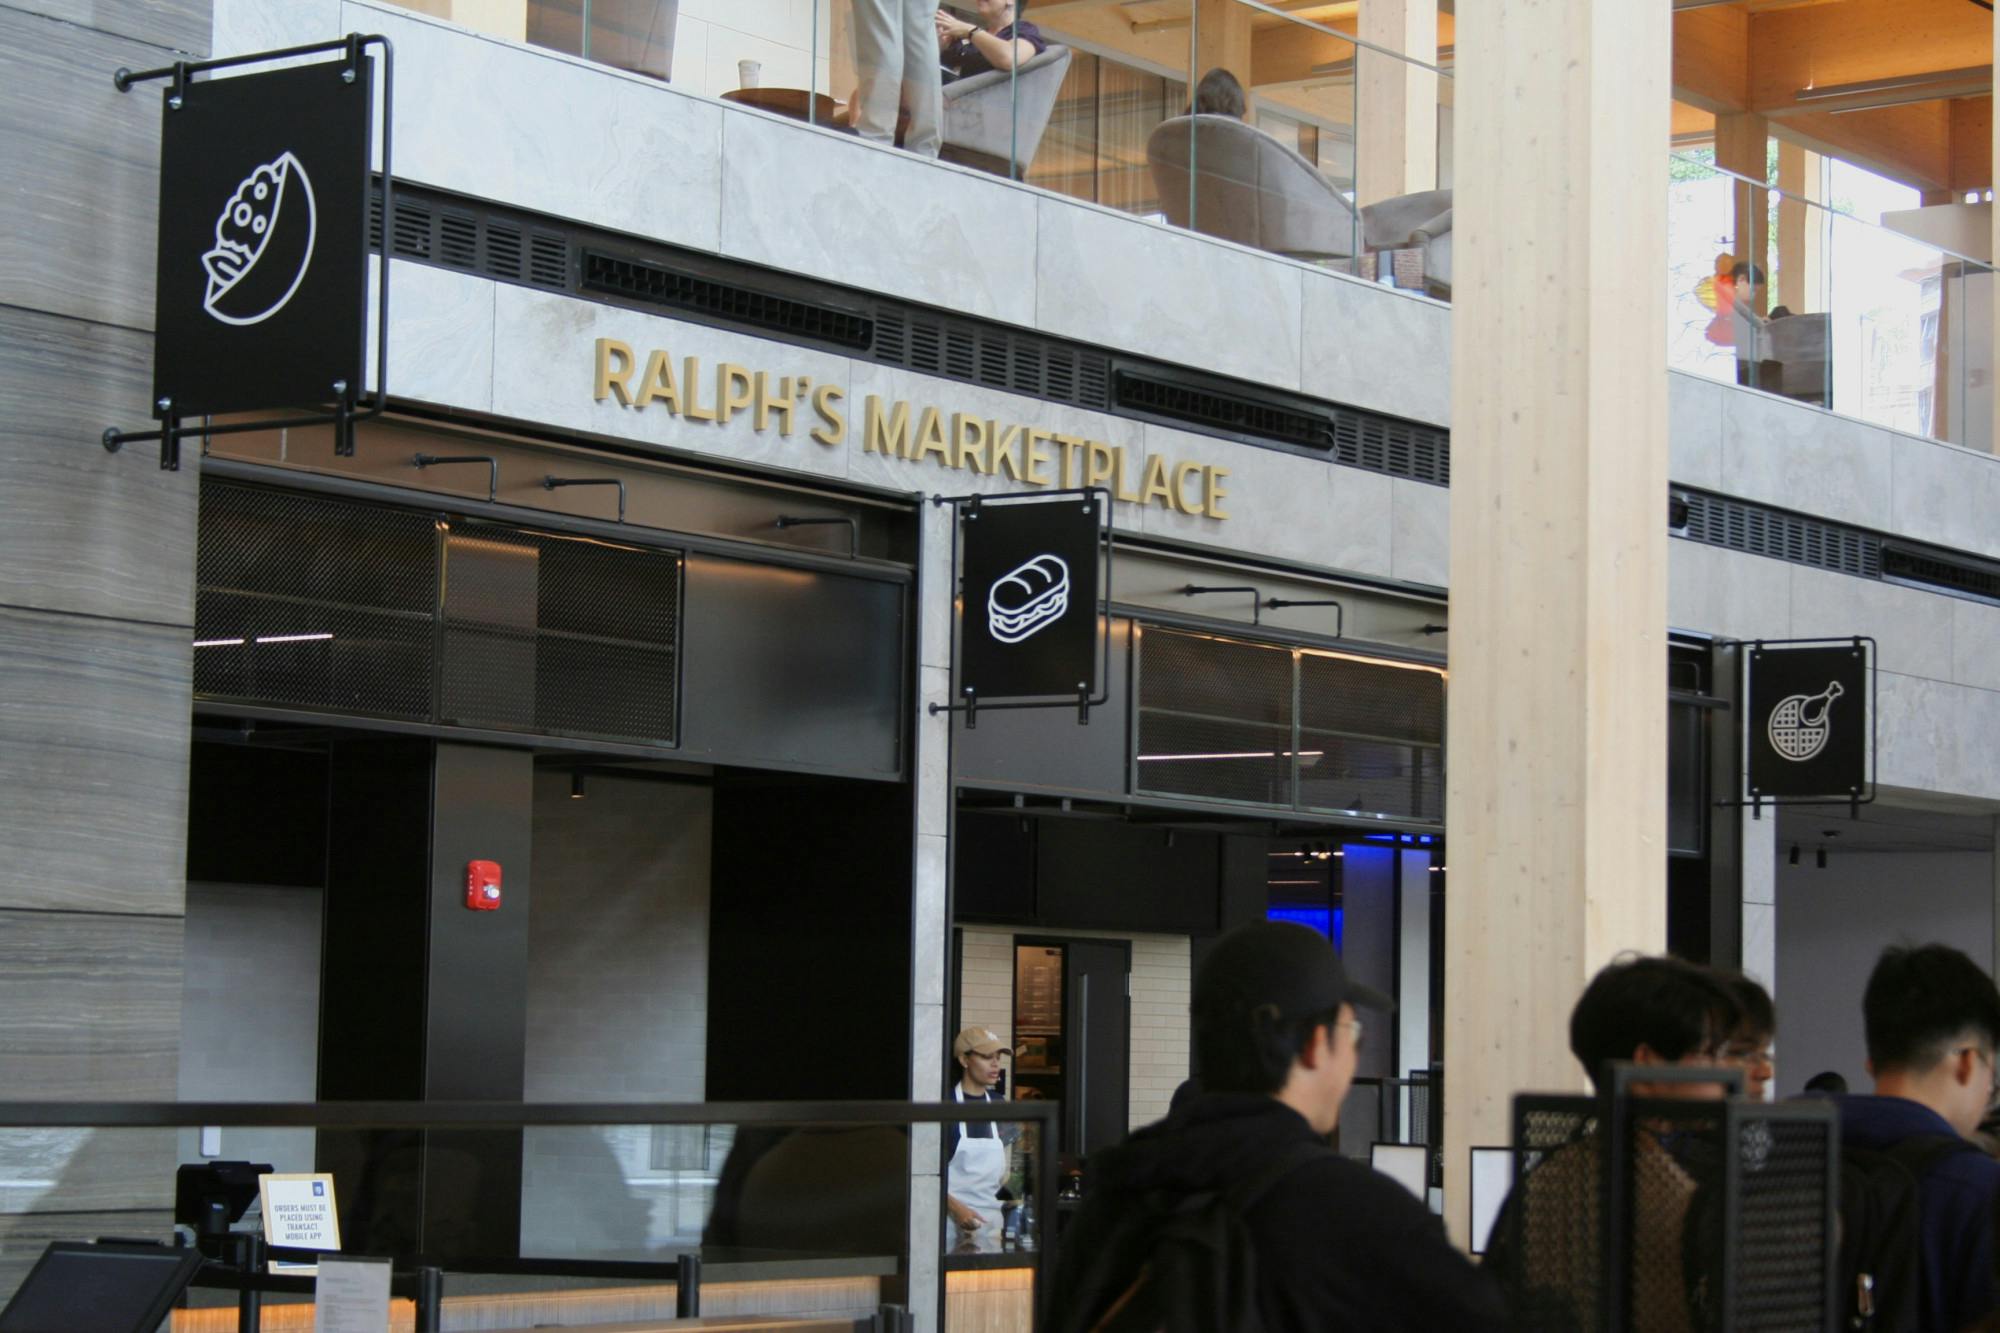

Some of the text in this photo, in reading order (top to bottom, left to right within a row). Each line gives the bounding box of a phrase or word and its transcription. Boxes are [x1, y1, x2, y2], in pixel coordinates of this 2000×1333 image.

[594, 337, 1230, 521] RALPH'S MARKETPLACE
[274, 1204, 299, 1212] ORDERS
[300, 1204, 317, 1212] MUST
[279, 1214, 303, 1222] PLACED
[287, 1223, 318, 1231] TRANSACT
[285, 1232, 322, 1240] MOBILE APP
